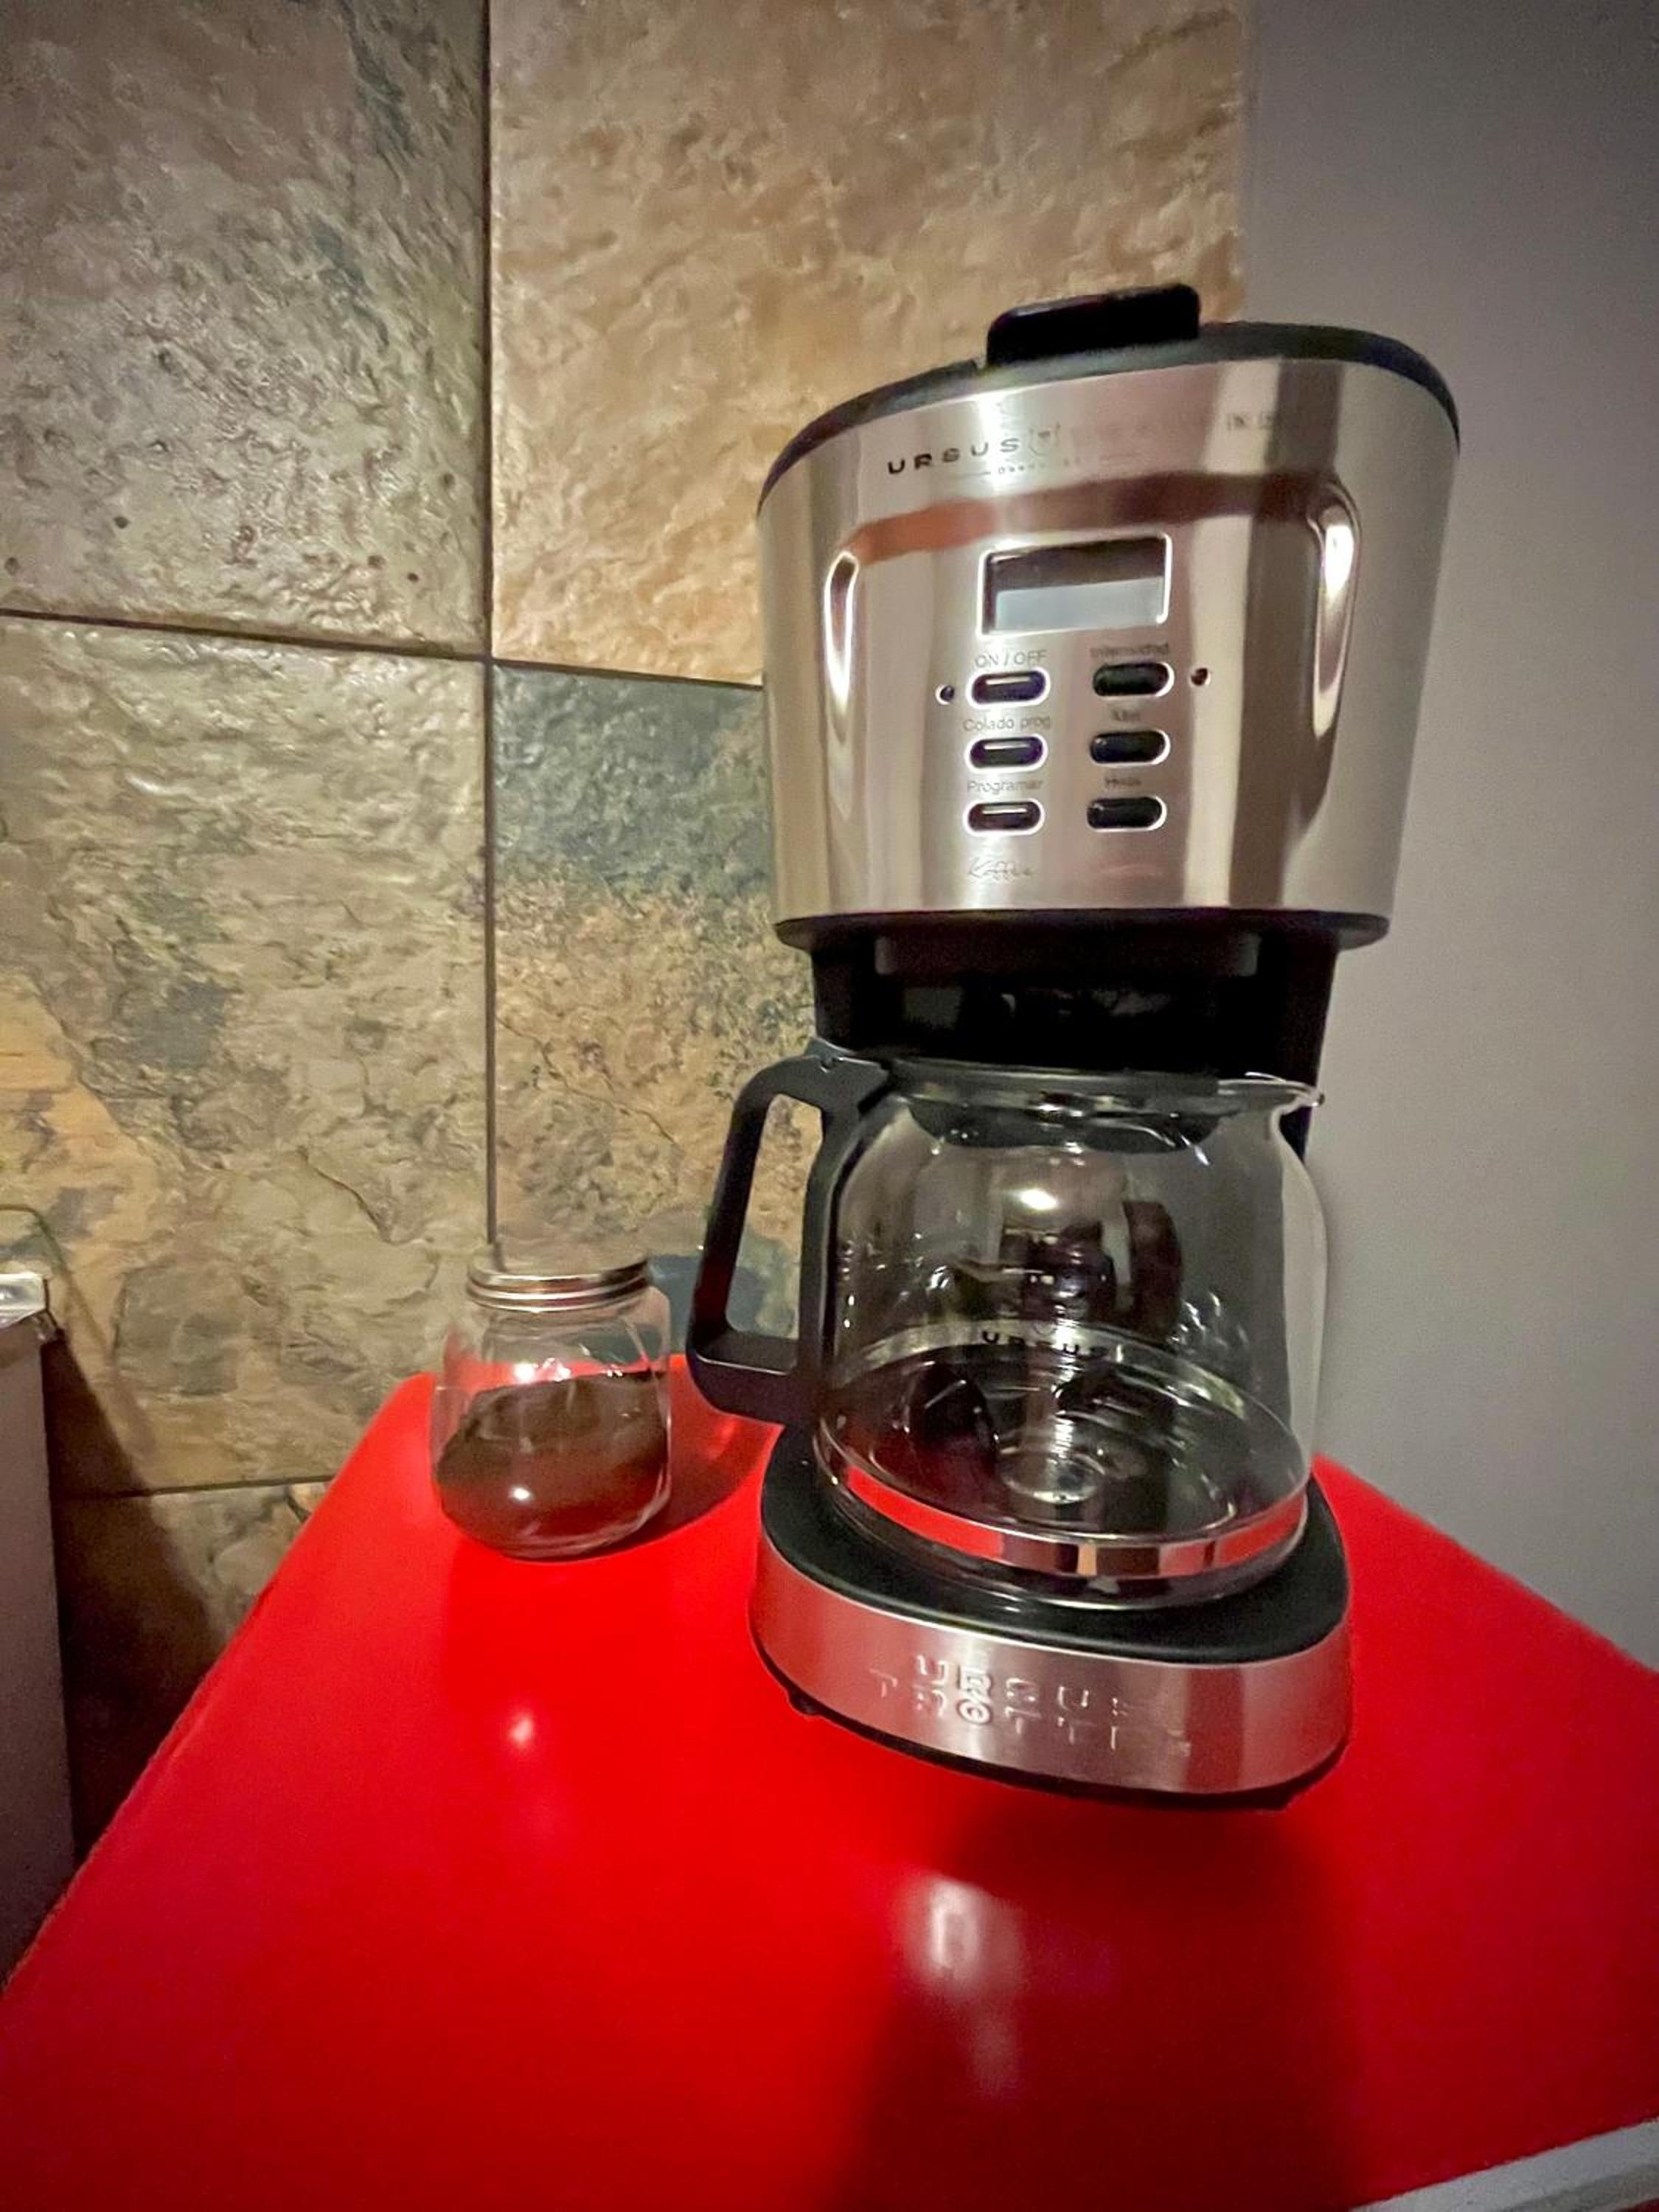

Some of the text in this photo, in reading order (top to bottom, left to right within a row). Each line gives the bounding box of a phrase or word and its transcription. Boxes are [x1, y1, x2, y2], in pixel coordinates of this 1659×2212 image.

[887, 438, 1019, 474] URSUS
[975, 653, 999, 667] ON
[1014, 649, 1046, 665] OFF
[962, 718, 1015, 732] Colado
